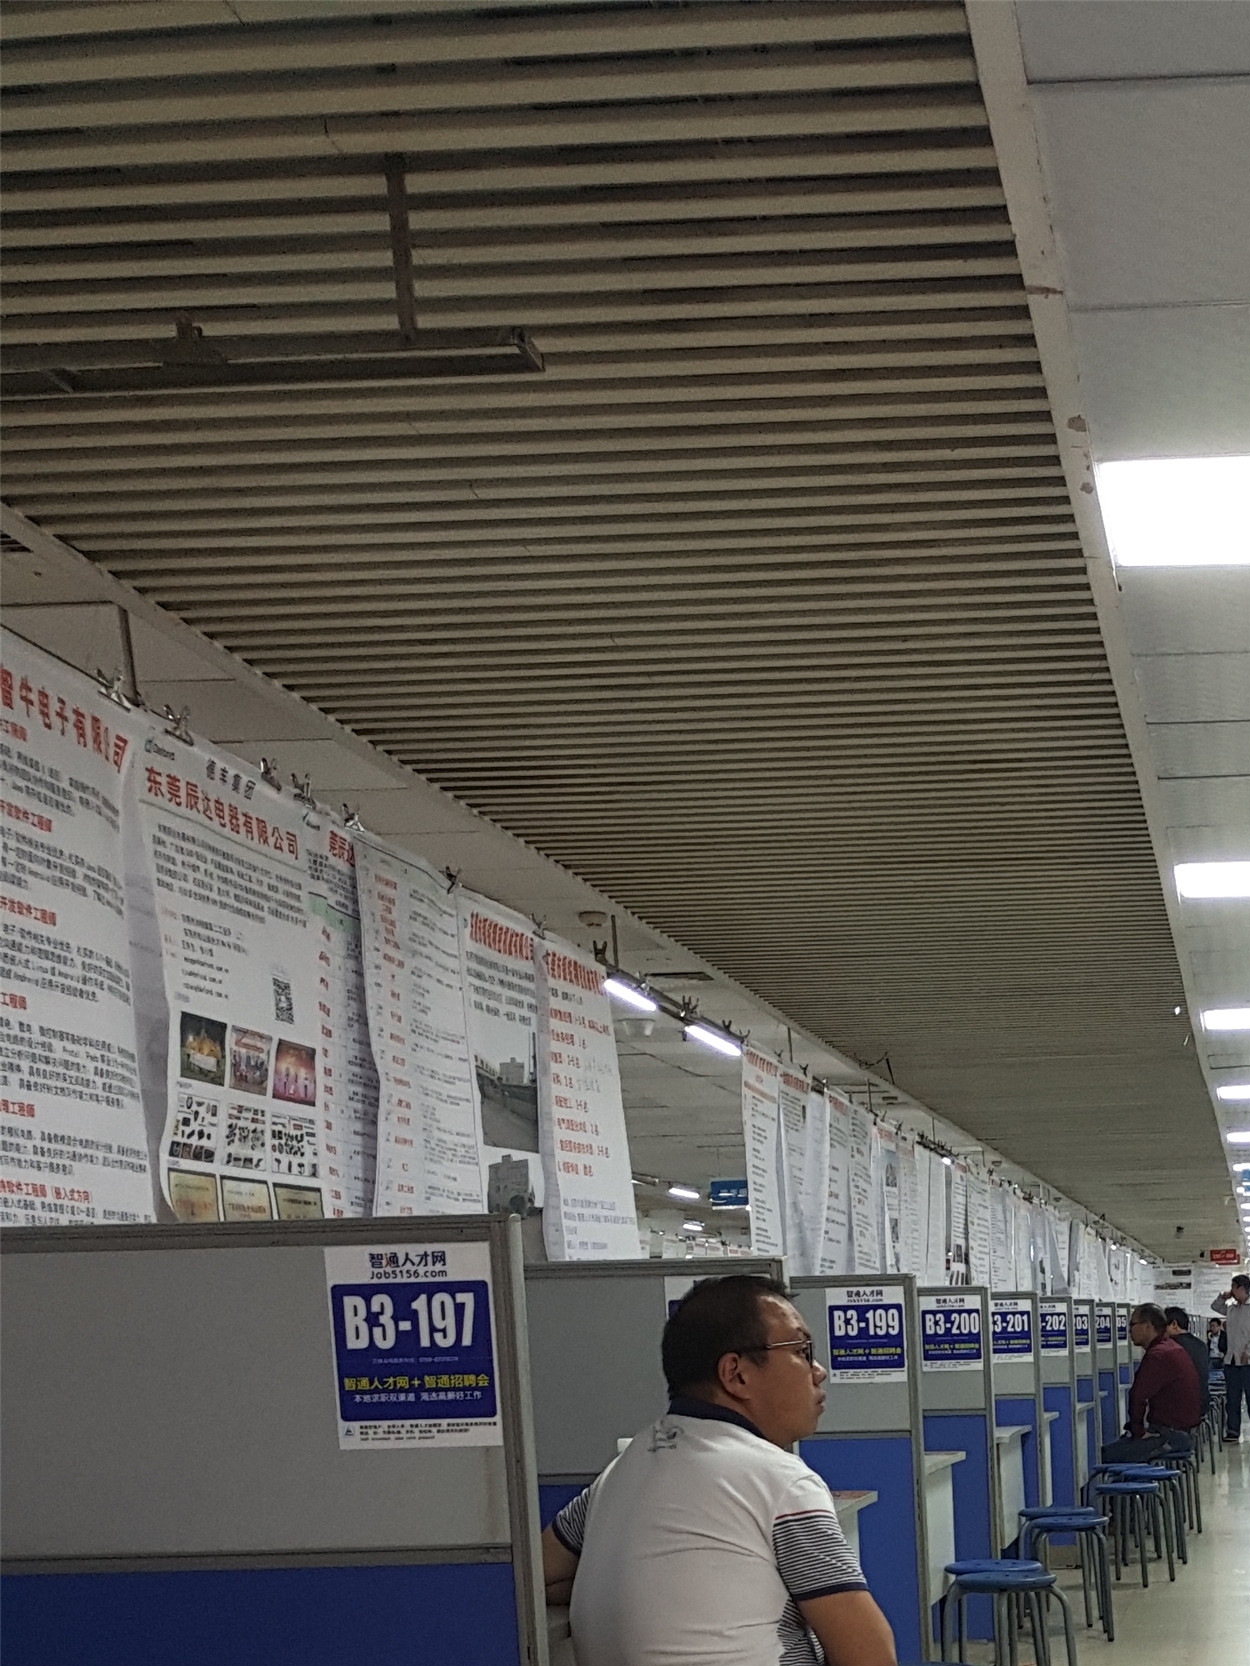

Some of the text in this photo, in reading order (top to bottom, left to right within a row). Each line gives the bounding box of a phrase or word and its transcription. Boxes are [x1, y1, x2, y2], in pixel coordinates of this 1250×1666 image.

[145, 766, 299, 860] 东莞辰达电器有限公司
[369, 1251, 446, 1268] 智通人才网
[370, 1269, 448, 1280] Job5156.com
[343, 1292, 475, 1350] B3-197
[833, 1308, 900, 1336] B3-199
[925, 1312, 979, 1335] B3-200
[992, 1314, 1028, 1333] 3-201
